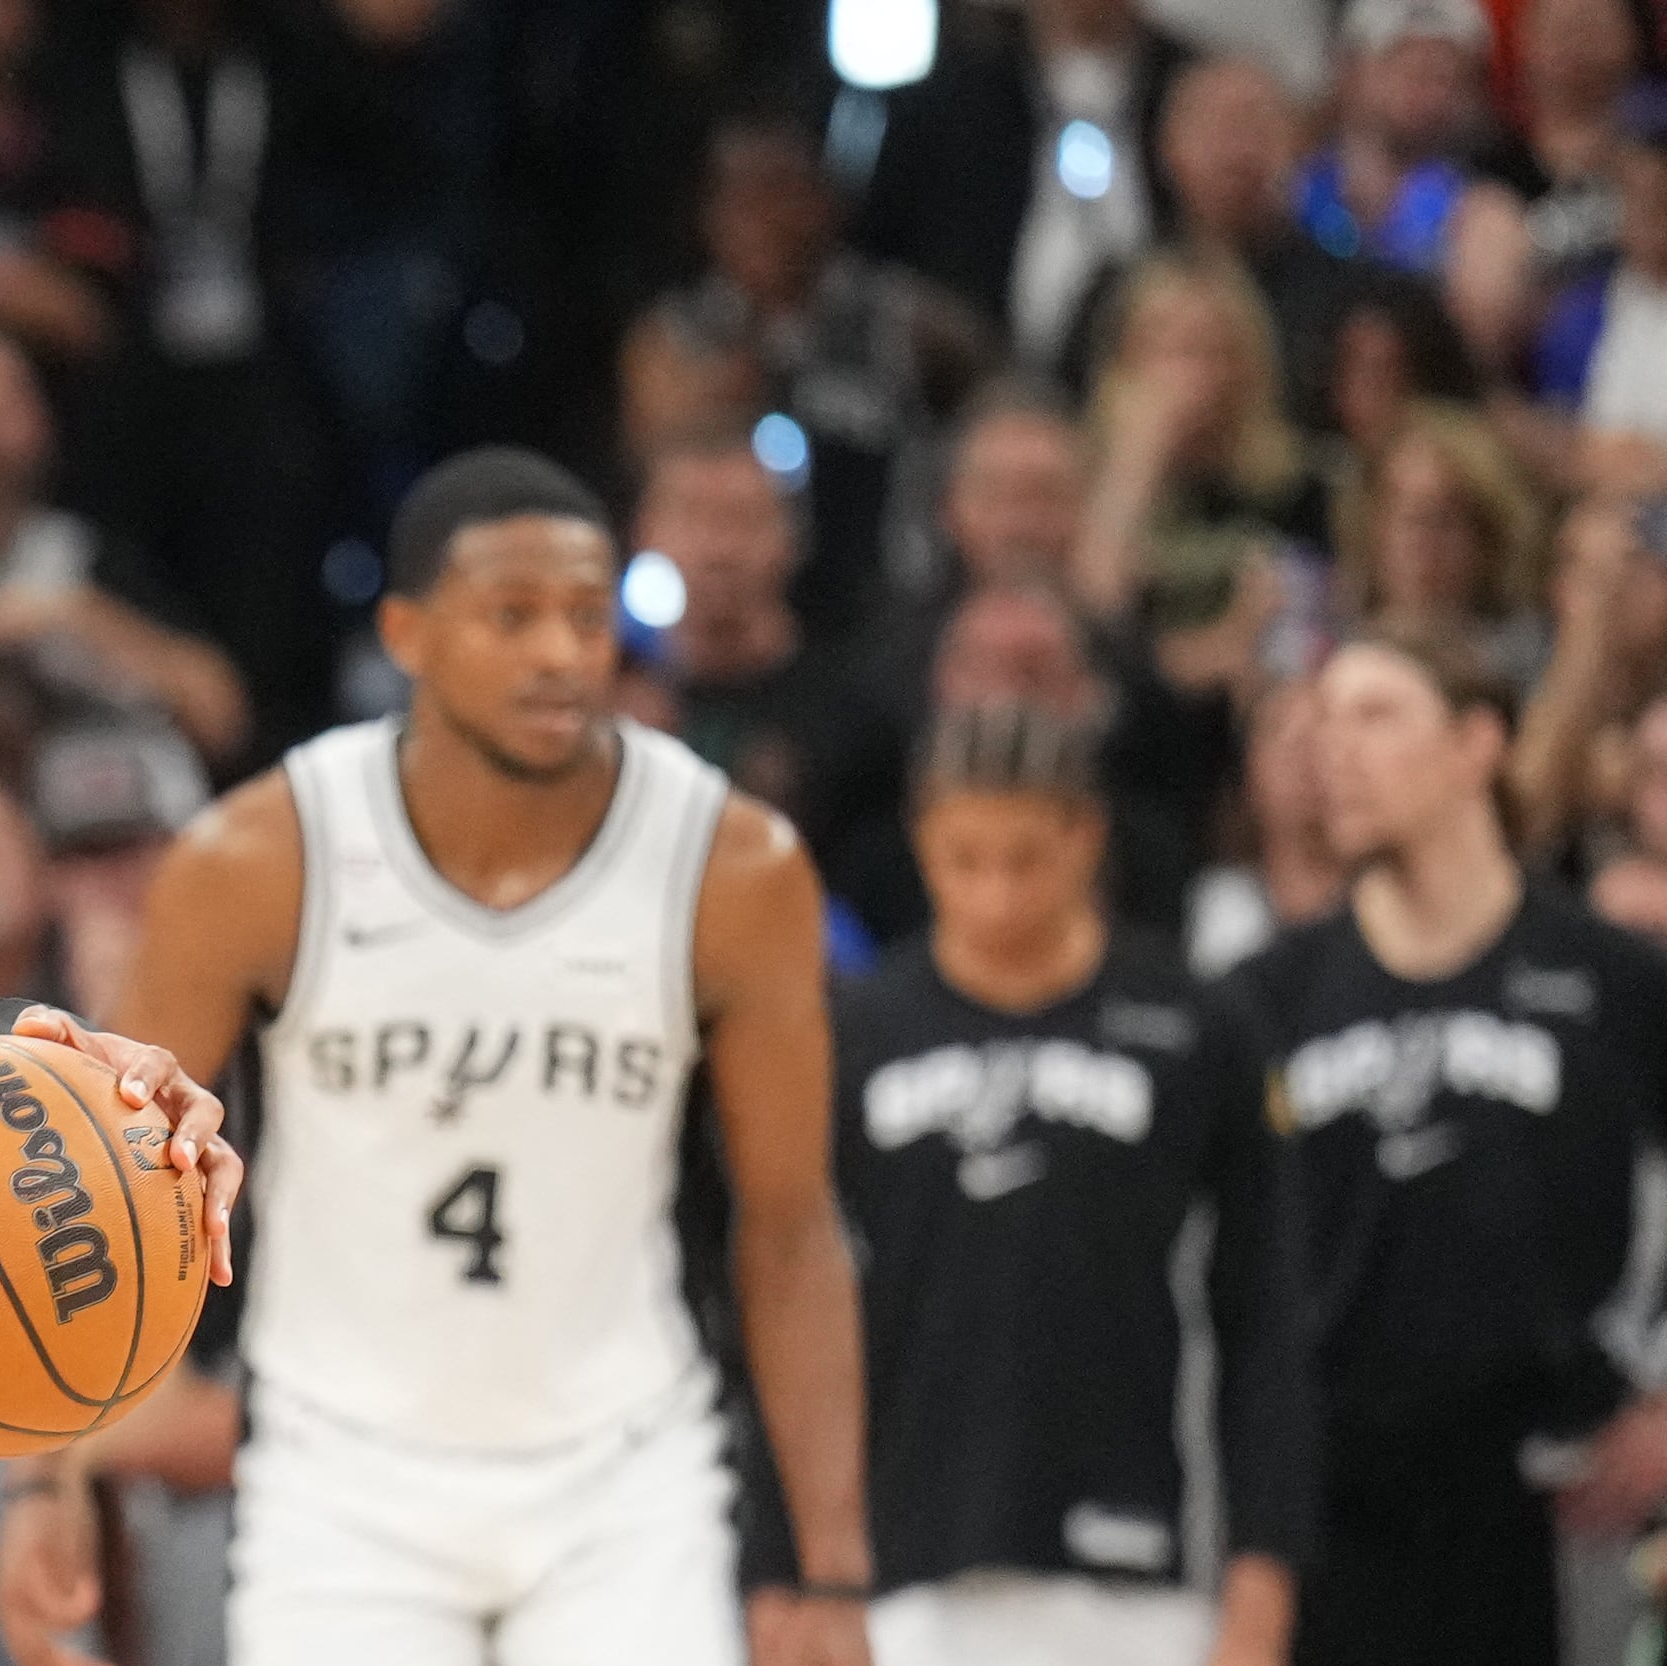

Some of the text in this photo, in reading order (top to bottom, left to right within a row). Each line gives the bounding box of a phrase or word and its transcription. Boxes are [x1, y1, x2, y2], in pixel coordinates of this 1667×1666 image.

[308, 1020, 665, 1130] SPURS
[178, 1239, 189, 1280] OFFICIAL
[427, 1165, 507, 1288] 4
